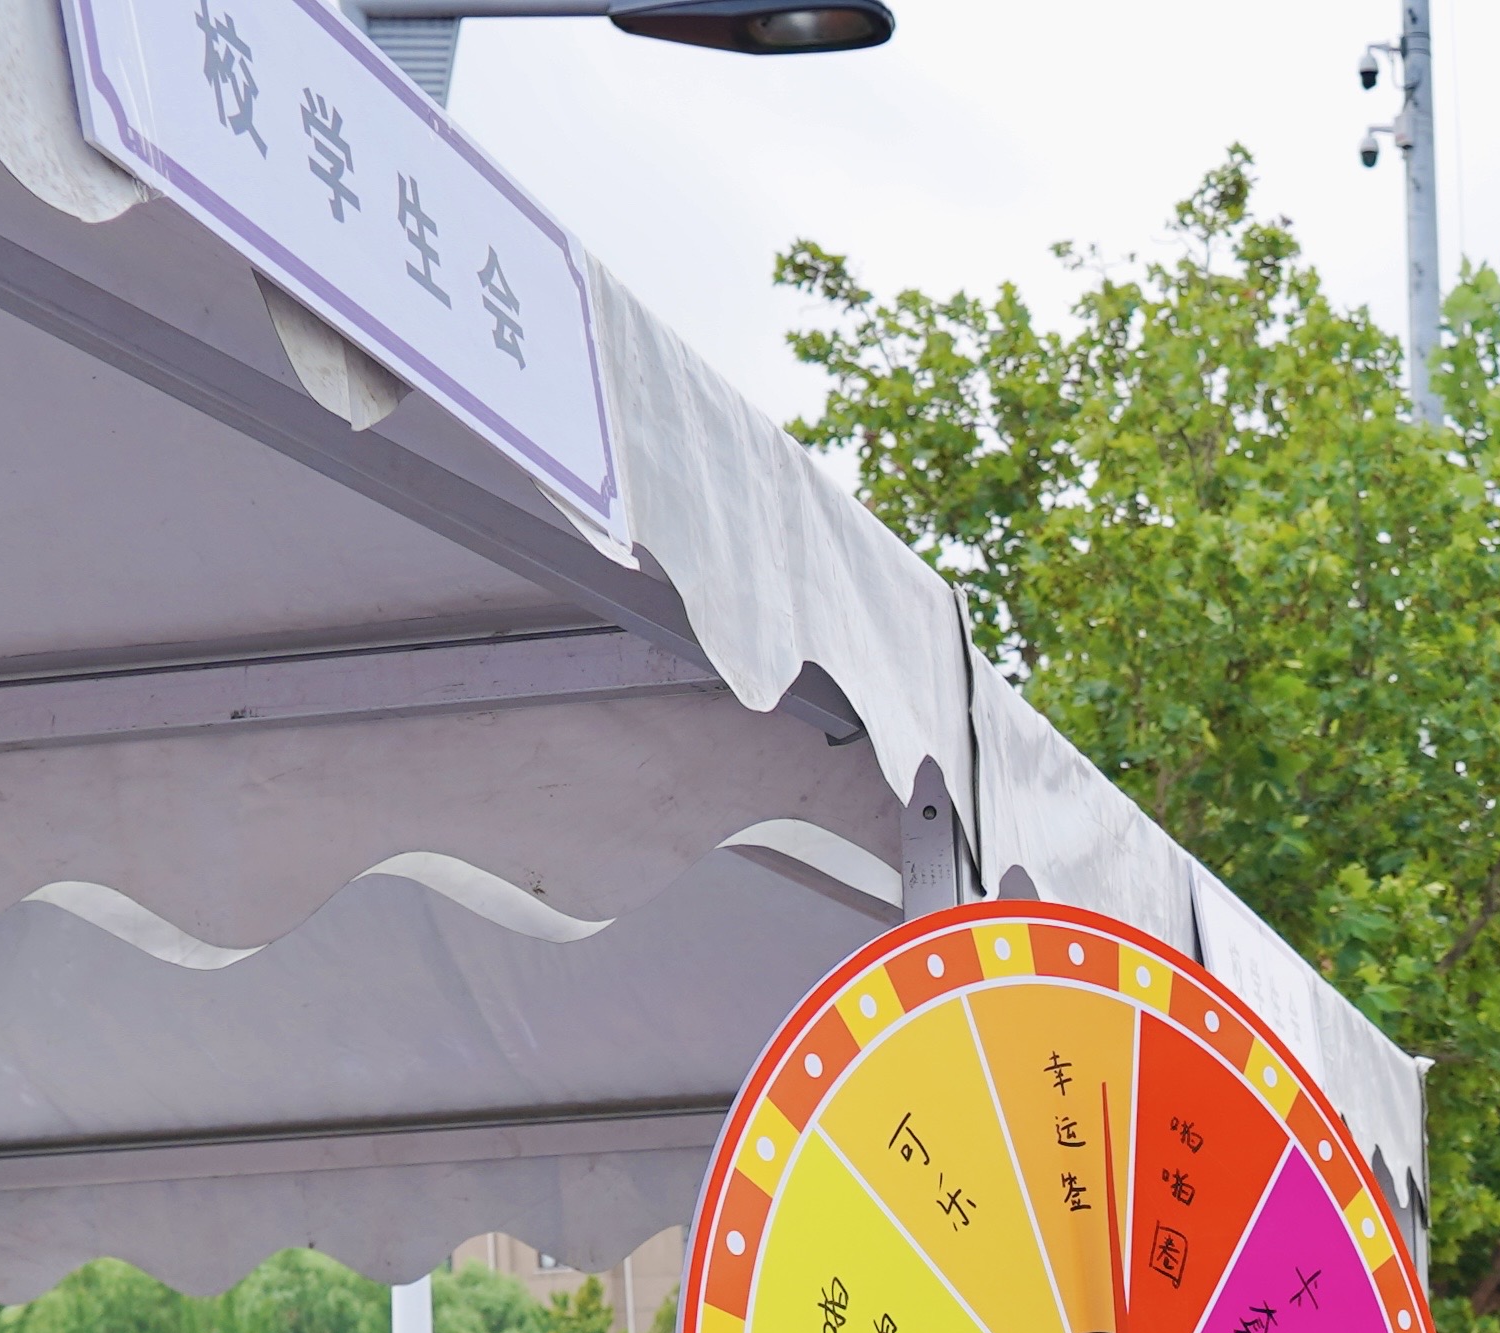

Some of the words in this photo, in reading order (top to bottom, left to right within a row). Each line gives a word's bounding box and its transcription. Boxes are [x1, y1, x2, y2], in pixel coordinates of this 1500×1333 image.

[195, 11, 527, 371] 校学生会
[887, 1112, 977, 1232] 可乐
